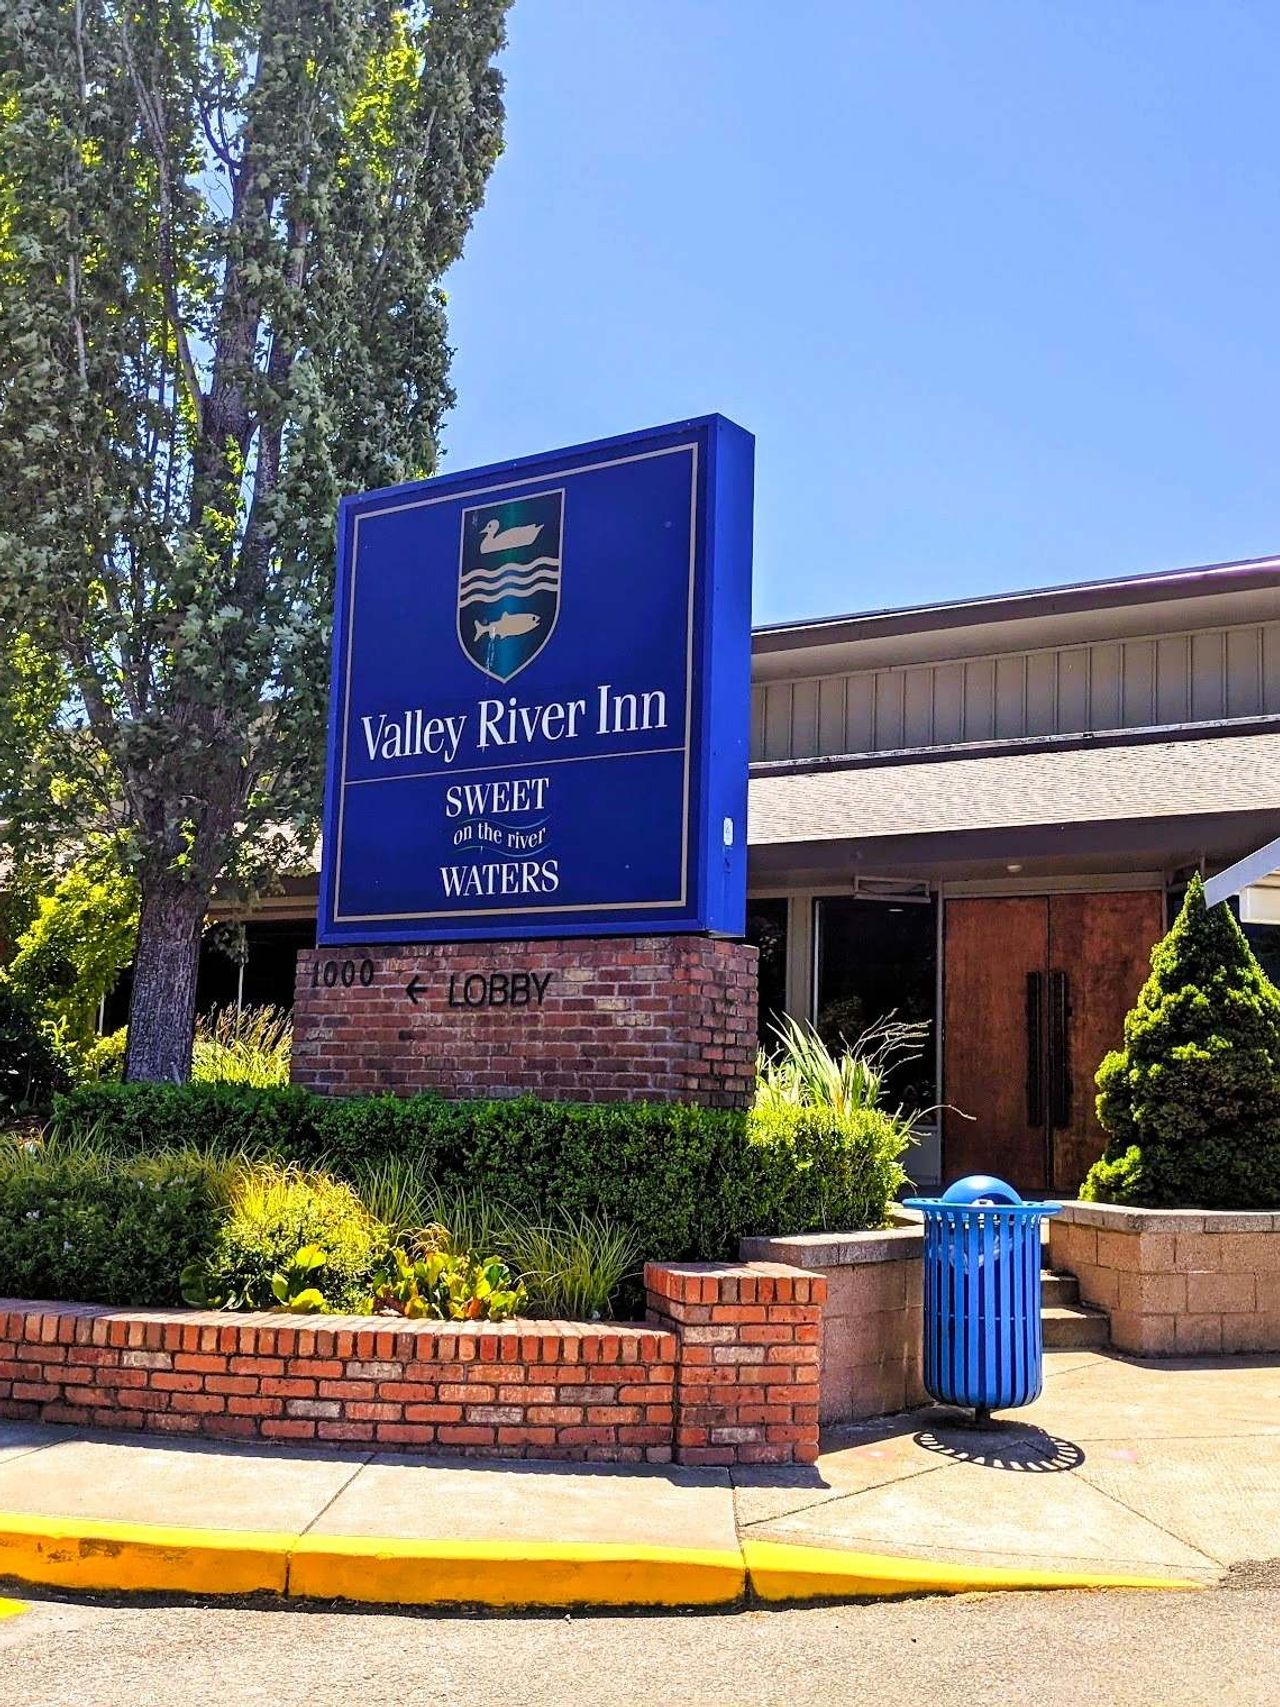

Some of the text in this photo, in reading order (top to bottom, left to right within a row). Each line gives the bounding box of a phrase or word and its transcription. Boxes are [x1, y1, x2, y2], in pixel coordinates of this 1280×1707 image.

[361, 684, 668, 763] Valley River Inn
[445, 777, 550, 818] SWEET
[453, 822, 546, 850] on the river
[440, 859, 560, 897] WATERS
[312, 957, 375, 989] 1000
[448, 972, 553, 1008] LOBBY
